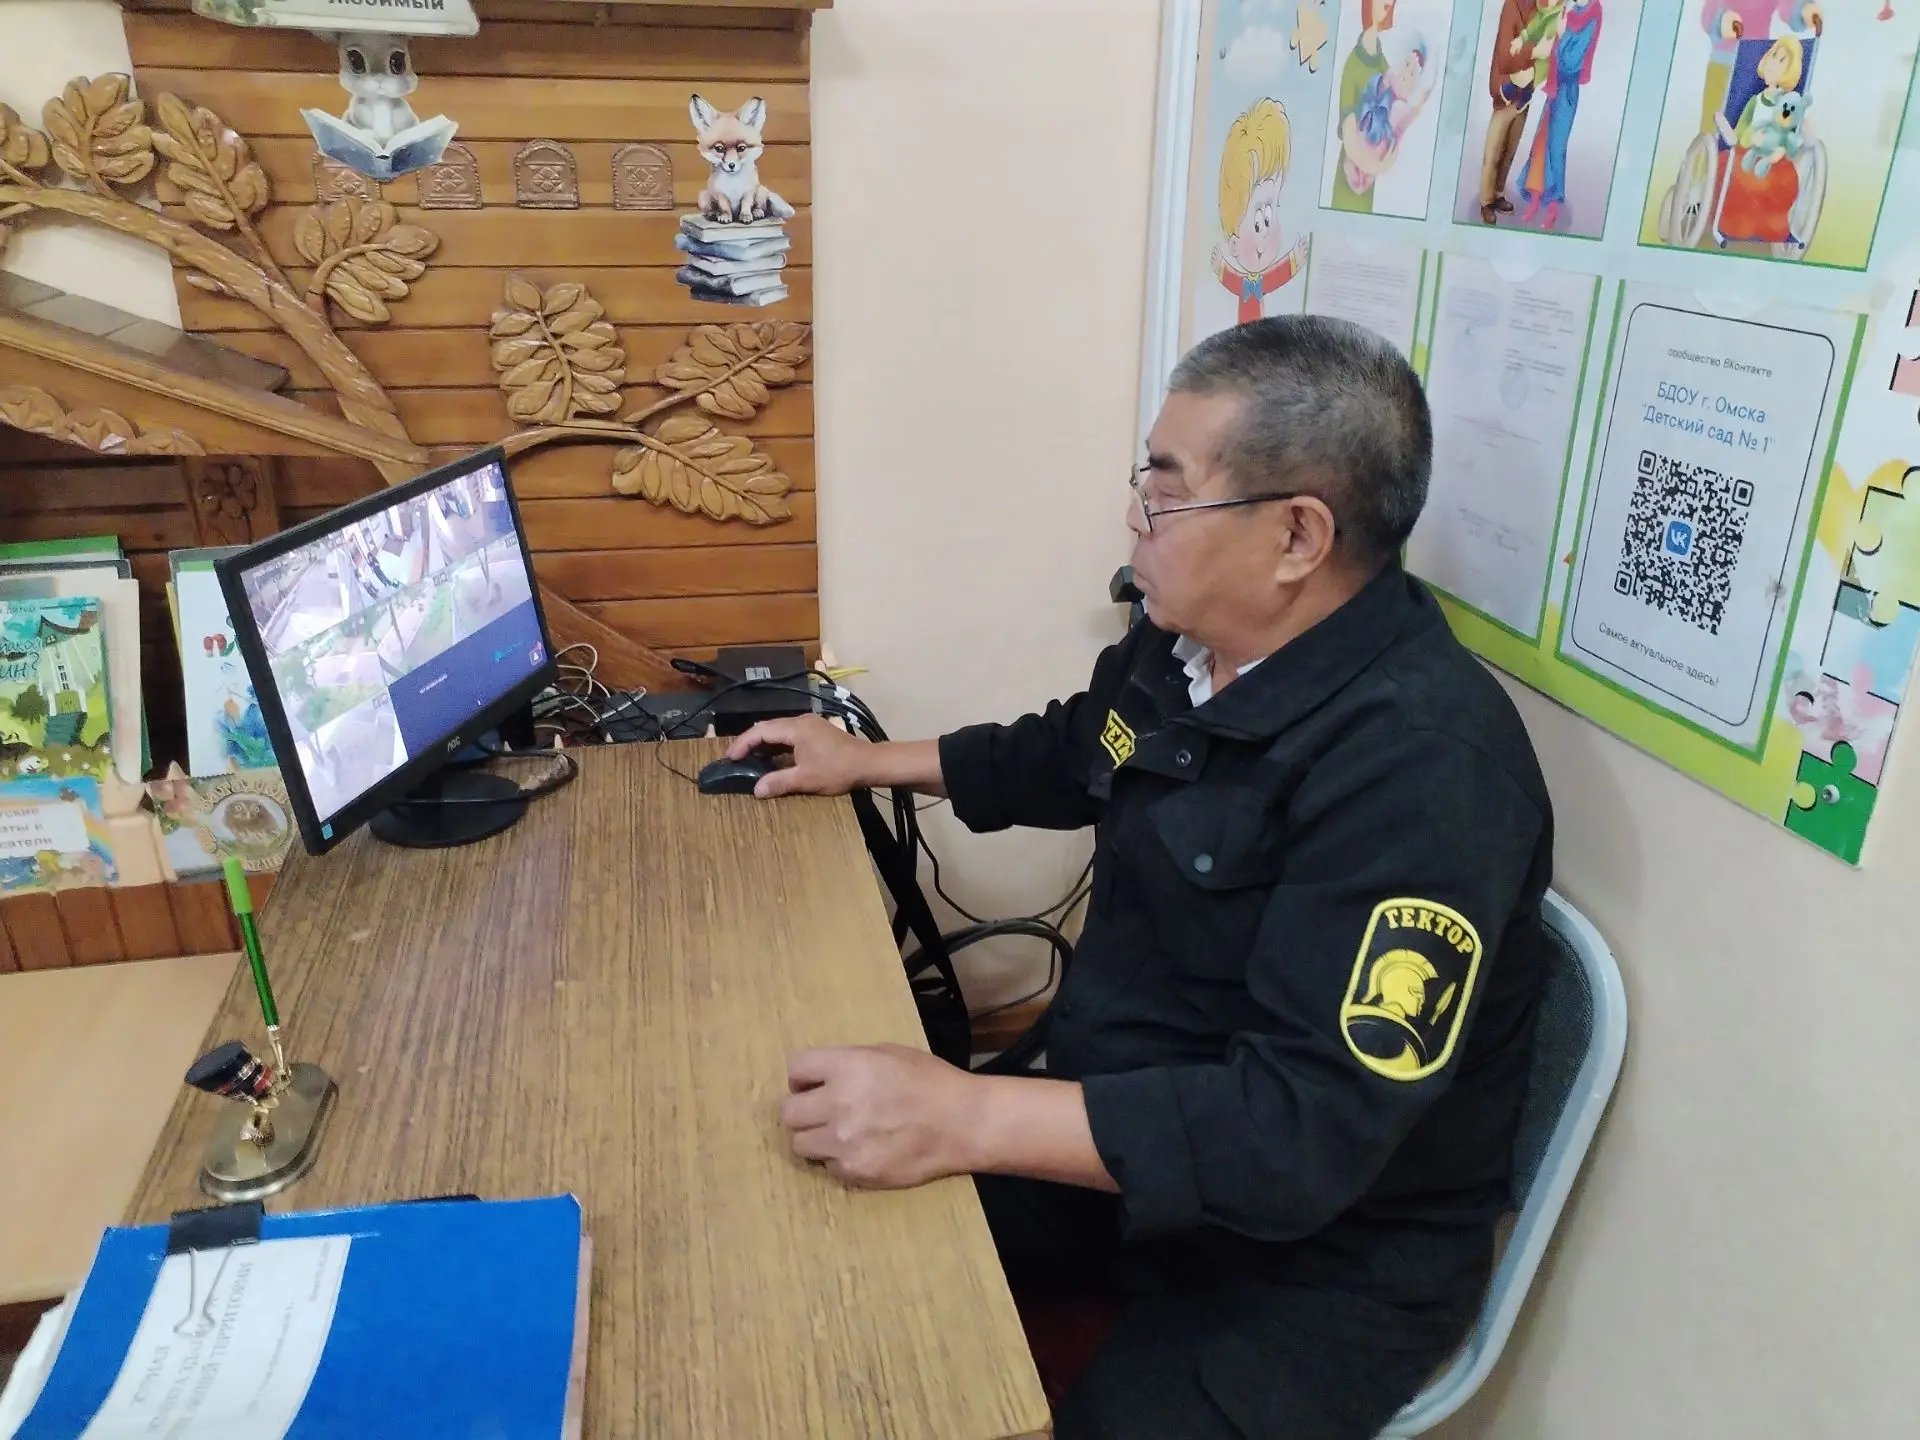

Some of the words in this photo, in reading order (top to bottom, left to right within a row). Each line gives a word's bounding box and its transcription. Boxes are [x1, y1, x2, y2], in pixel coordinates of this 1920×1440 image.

[328, 0, 444, 10] ИМЫЙ
[1667, 348, 1721, 366] сообщество
[1723, 358, 1773, 378] ВКонтакте
[1657, 381, 1699, 405] БДОУ
[1701, 396, 1711, 410] г.
[1715, 396, 1766, 424] Омска
[1642, 403, 1705, 435] "Детский
[1707, 426, 1734, 447] сад
[1738, 430, 1758, 451] №
[1598, 622, 1629, 644] Самое
[1629, 639, 1684, 671] актуальное
[1685, 668, 1720, 687] здесь!
[1384, 907, 1474, 954] ГЕКТОР
